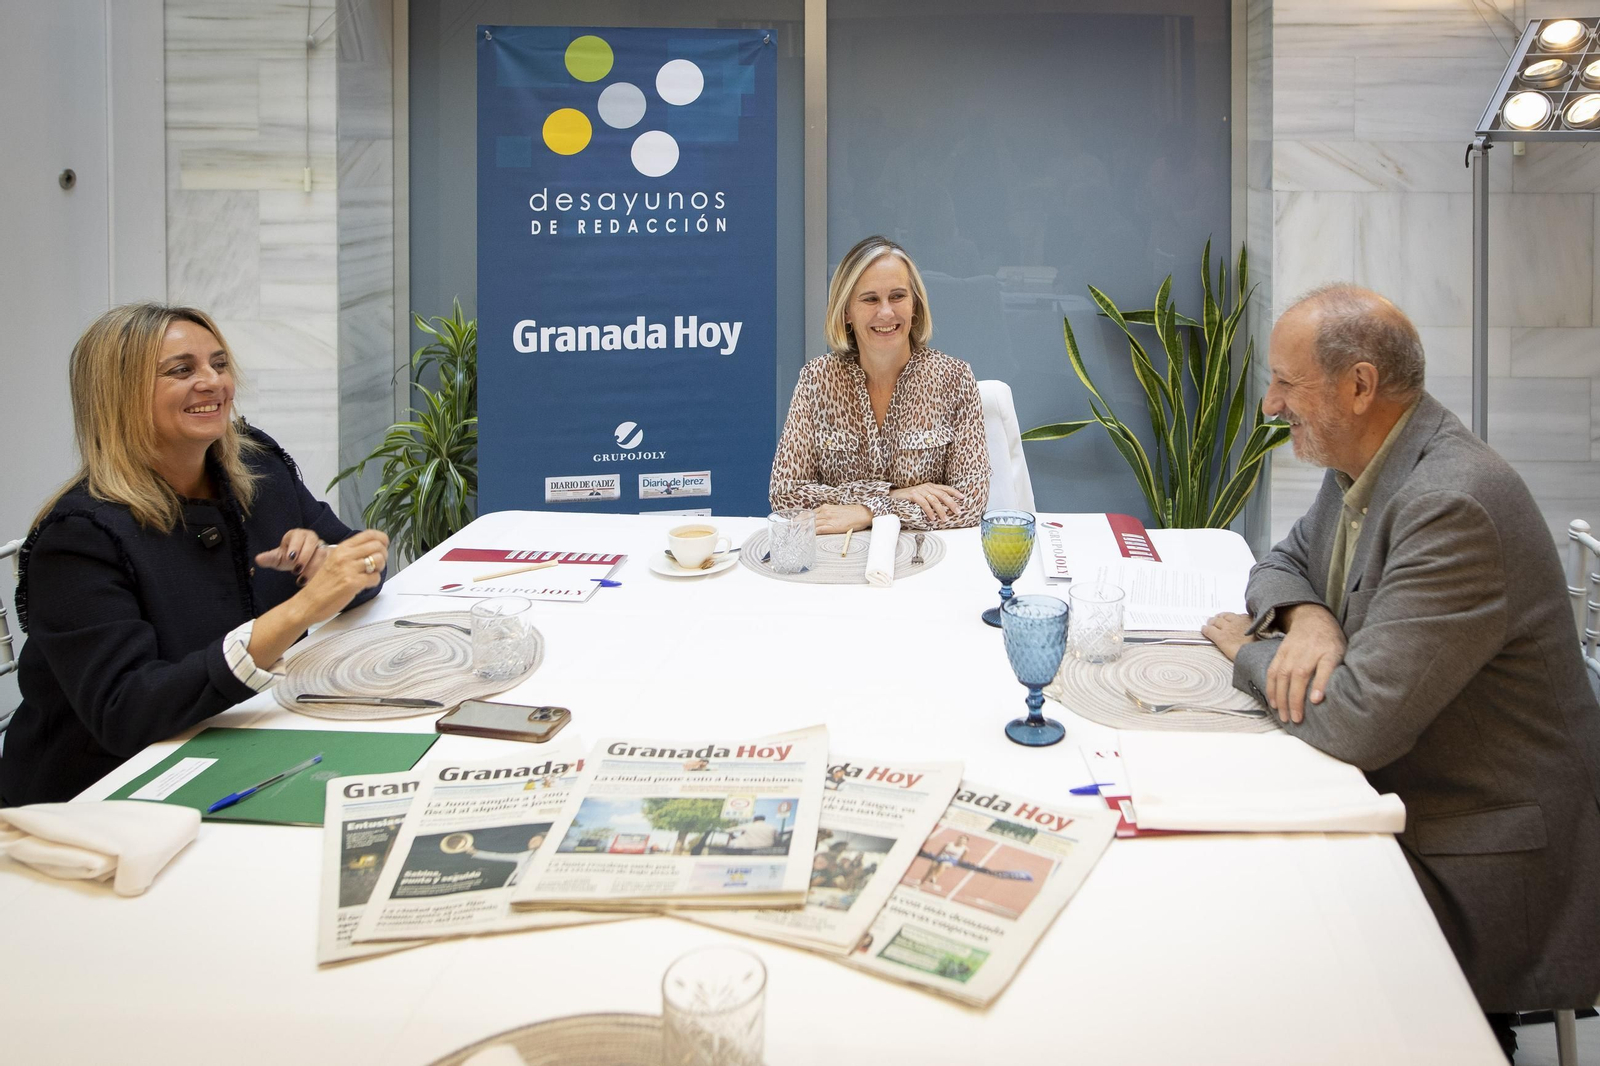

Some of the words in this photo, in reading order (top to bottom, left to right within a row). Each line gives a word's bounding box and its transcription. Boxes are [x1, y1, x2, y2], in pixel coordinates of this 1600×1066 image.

[529, 187, 726, 216] desayunos
[531, 220, 558, 235] DE
[577, 214, 727, 234] REDACCIÓN
[512, 316, 667, 354] Granada
[674, 315, 743, 356] Hoy
[550, 481, 579, 490] DIARIO
[579, 480, 591, 489] DE
[642, 478, 669, 487] Diario
[669, 477, 681, 486] de
[682, 477, 705, 487] Jerez
[607, 742, 731, 759] Granada
[736, 744, 793, 762] Hoy
[439, 760, 570, 782] Granada
[865, 766, 924, 789] Hoy
[1013, 802, 1075, 832] Hoy
